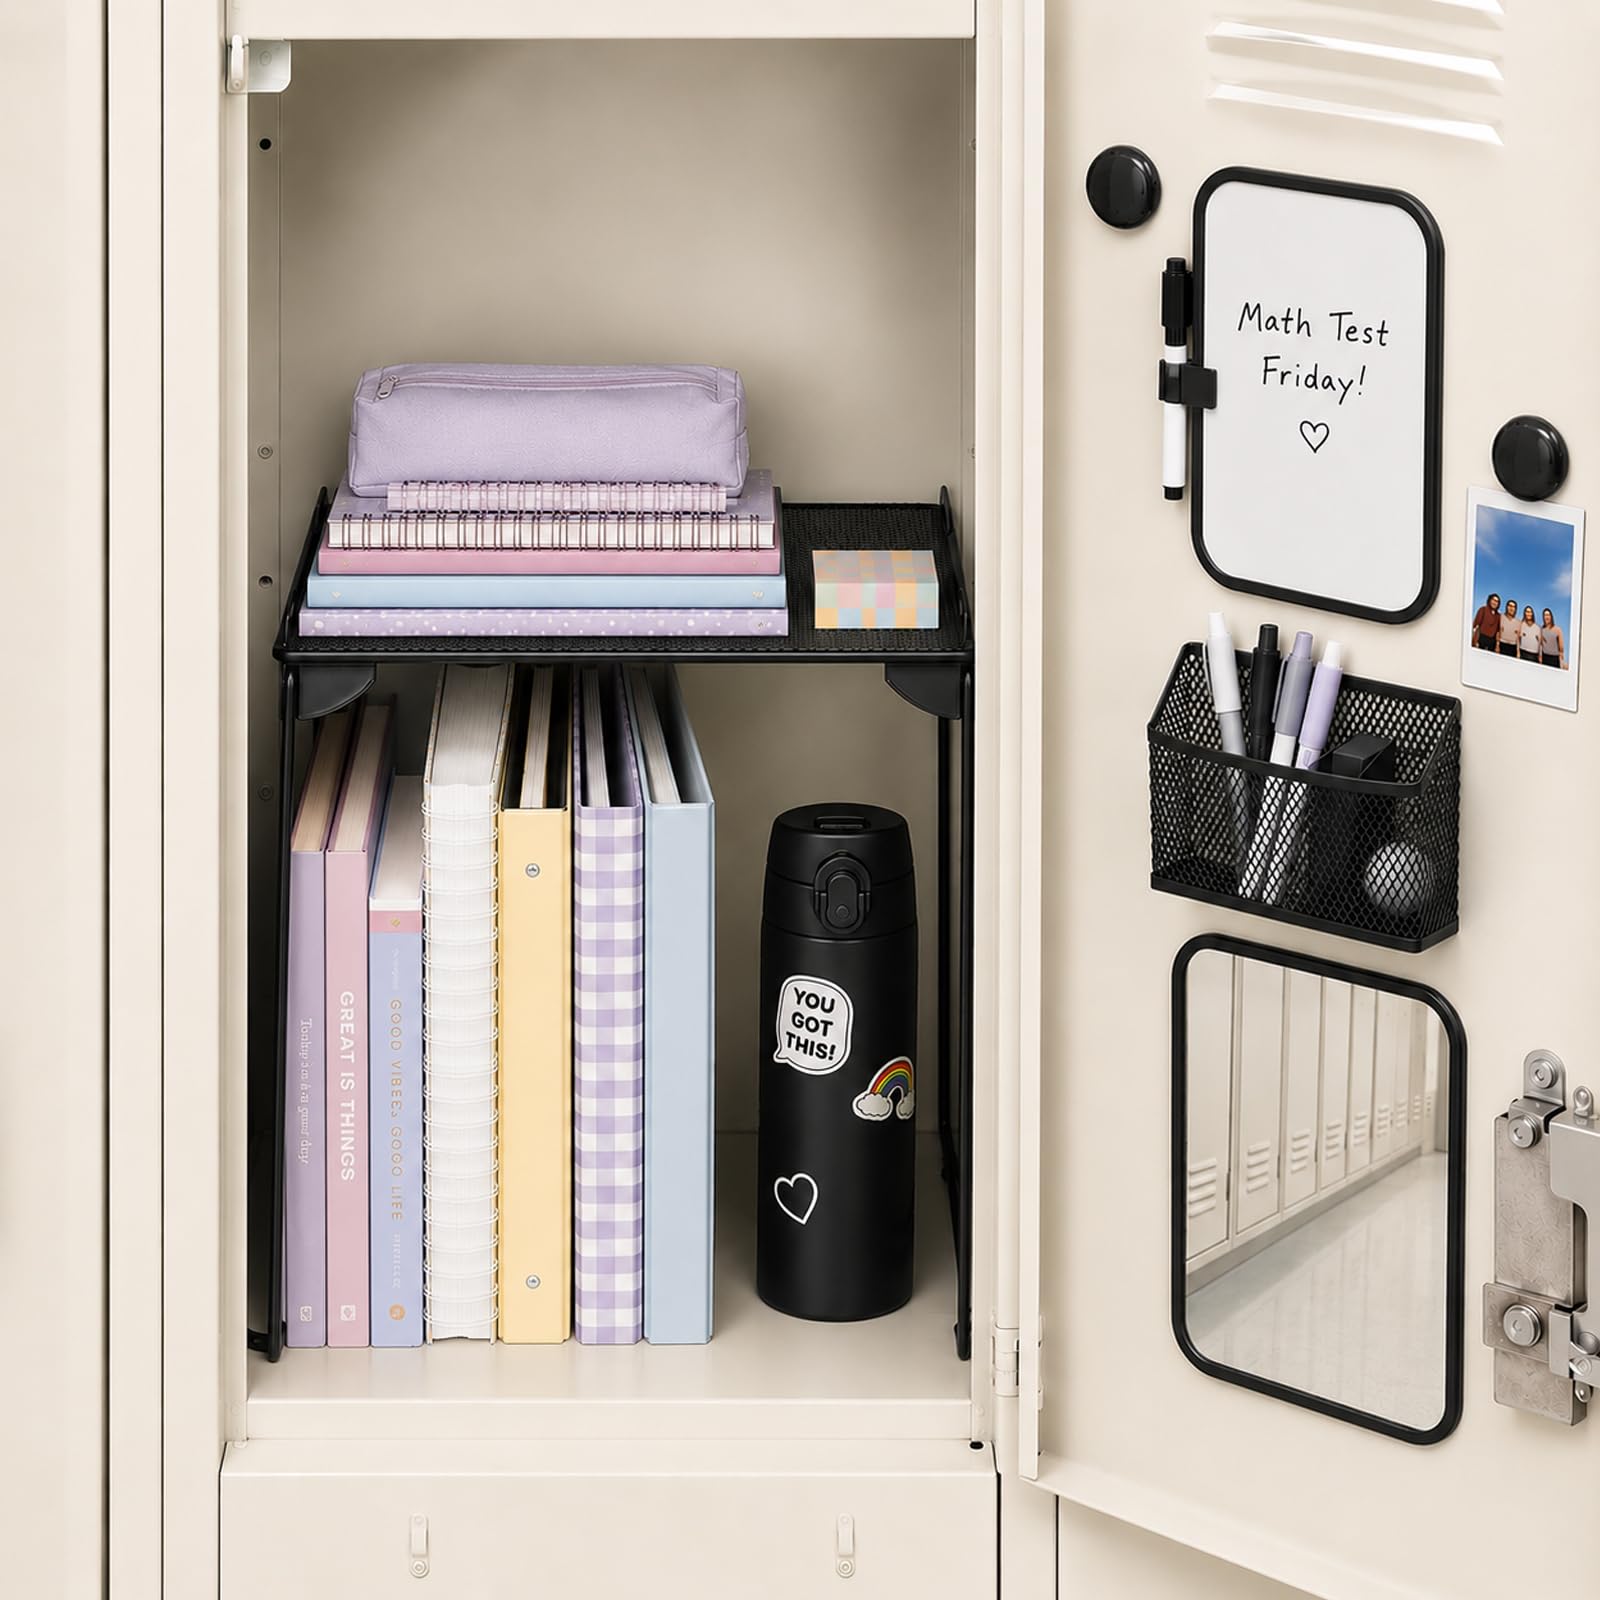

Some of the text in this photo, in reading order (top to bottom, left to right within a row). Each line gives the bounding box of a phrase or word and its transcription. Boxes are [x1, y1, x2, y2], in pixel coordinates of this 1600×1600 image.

[1237, 302, 1389, 346] Math Test
[1263, 355, 1366, 405] Friday!
[794, 987, 834, 1013] YOU
[390, 999, 402, 1051] GOOD
[786, 1032, 836, 1060] THIS!
[792, 1012, 833, 1036] GOT
[340, 990, 355, 1181] GREAT IS THINGS
